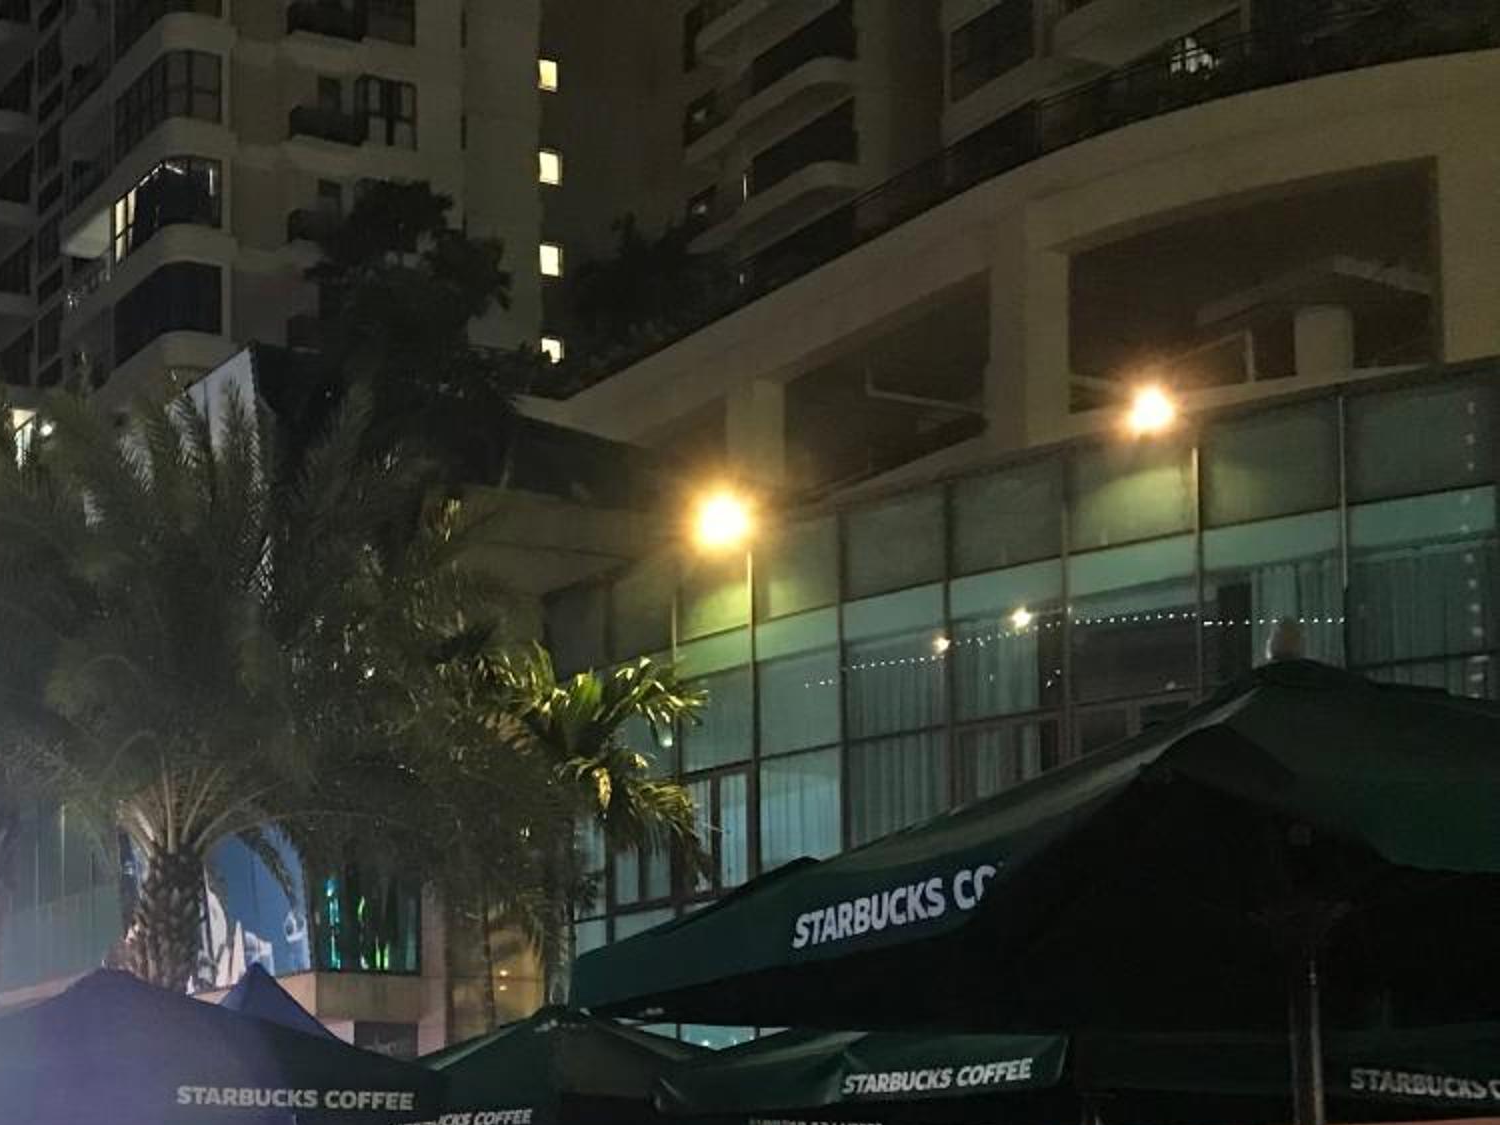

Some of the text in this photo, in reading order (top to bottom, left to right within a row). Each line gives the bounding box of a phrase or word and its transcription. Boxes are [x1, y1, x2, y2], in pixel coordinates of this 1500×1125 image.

[791, 877, 947, 949] STARBUCKS
[841, 1057, 1033, 1095] STARBUCKS COFFEE
[1349, 1067, 1487, 1099] STARBUCKS
[176, 1086, 415, 1111] STARBUCKS COFFEE
